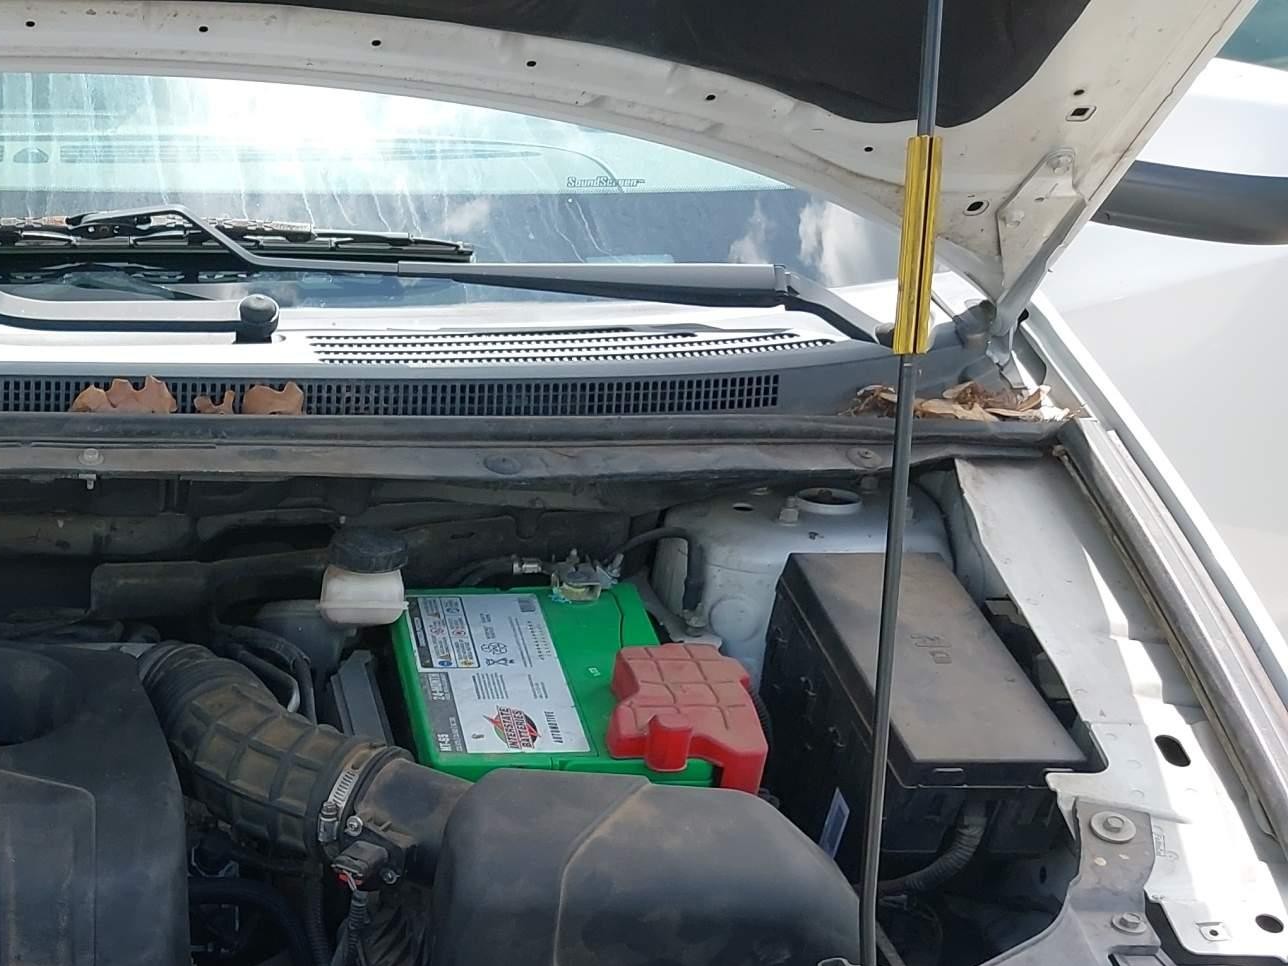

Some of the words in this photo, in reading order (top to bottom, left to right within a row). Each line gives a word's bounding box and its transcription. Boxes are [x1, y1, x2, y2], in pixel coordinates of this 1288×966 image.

[499, 706, 519, 749] INTERSTATE
[512, 709, 533, 749] BATTERIES
[544, 710, 564, 744] AUTOMOTIVE
